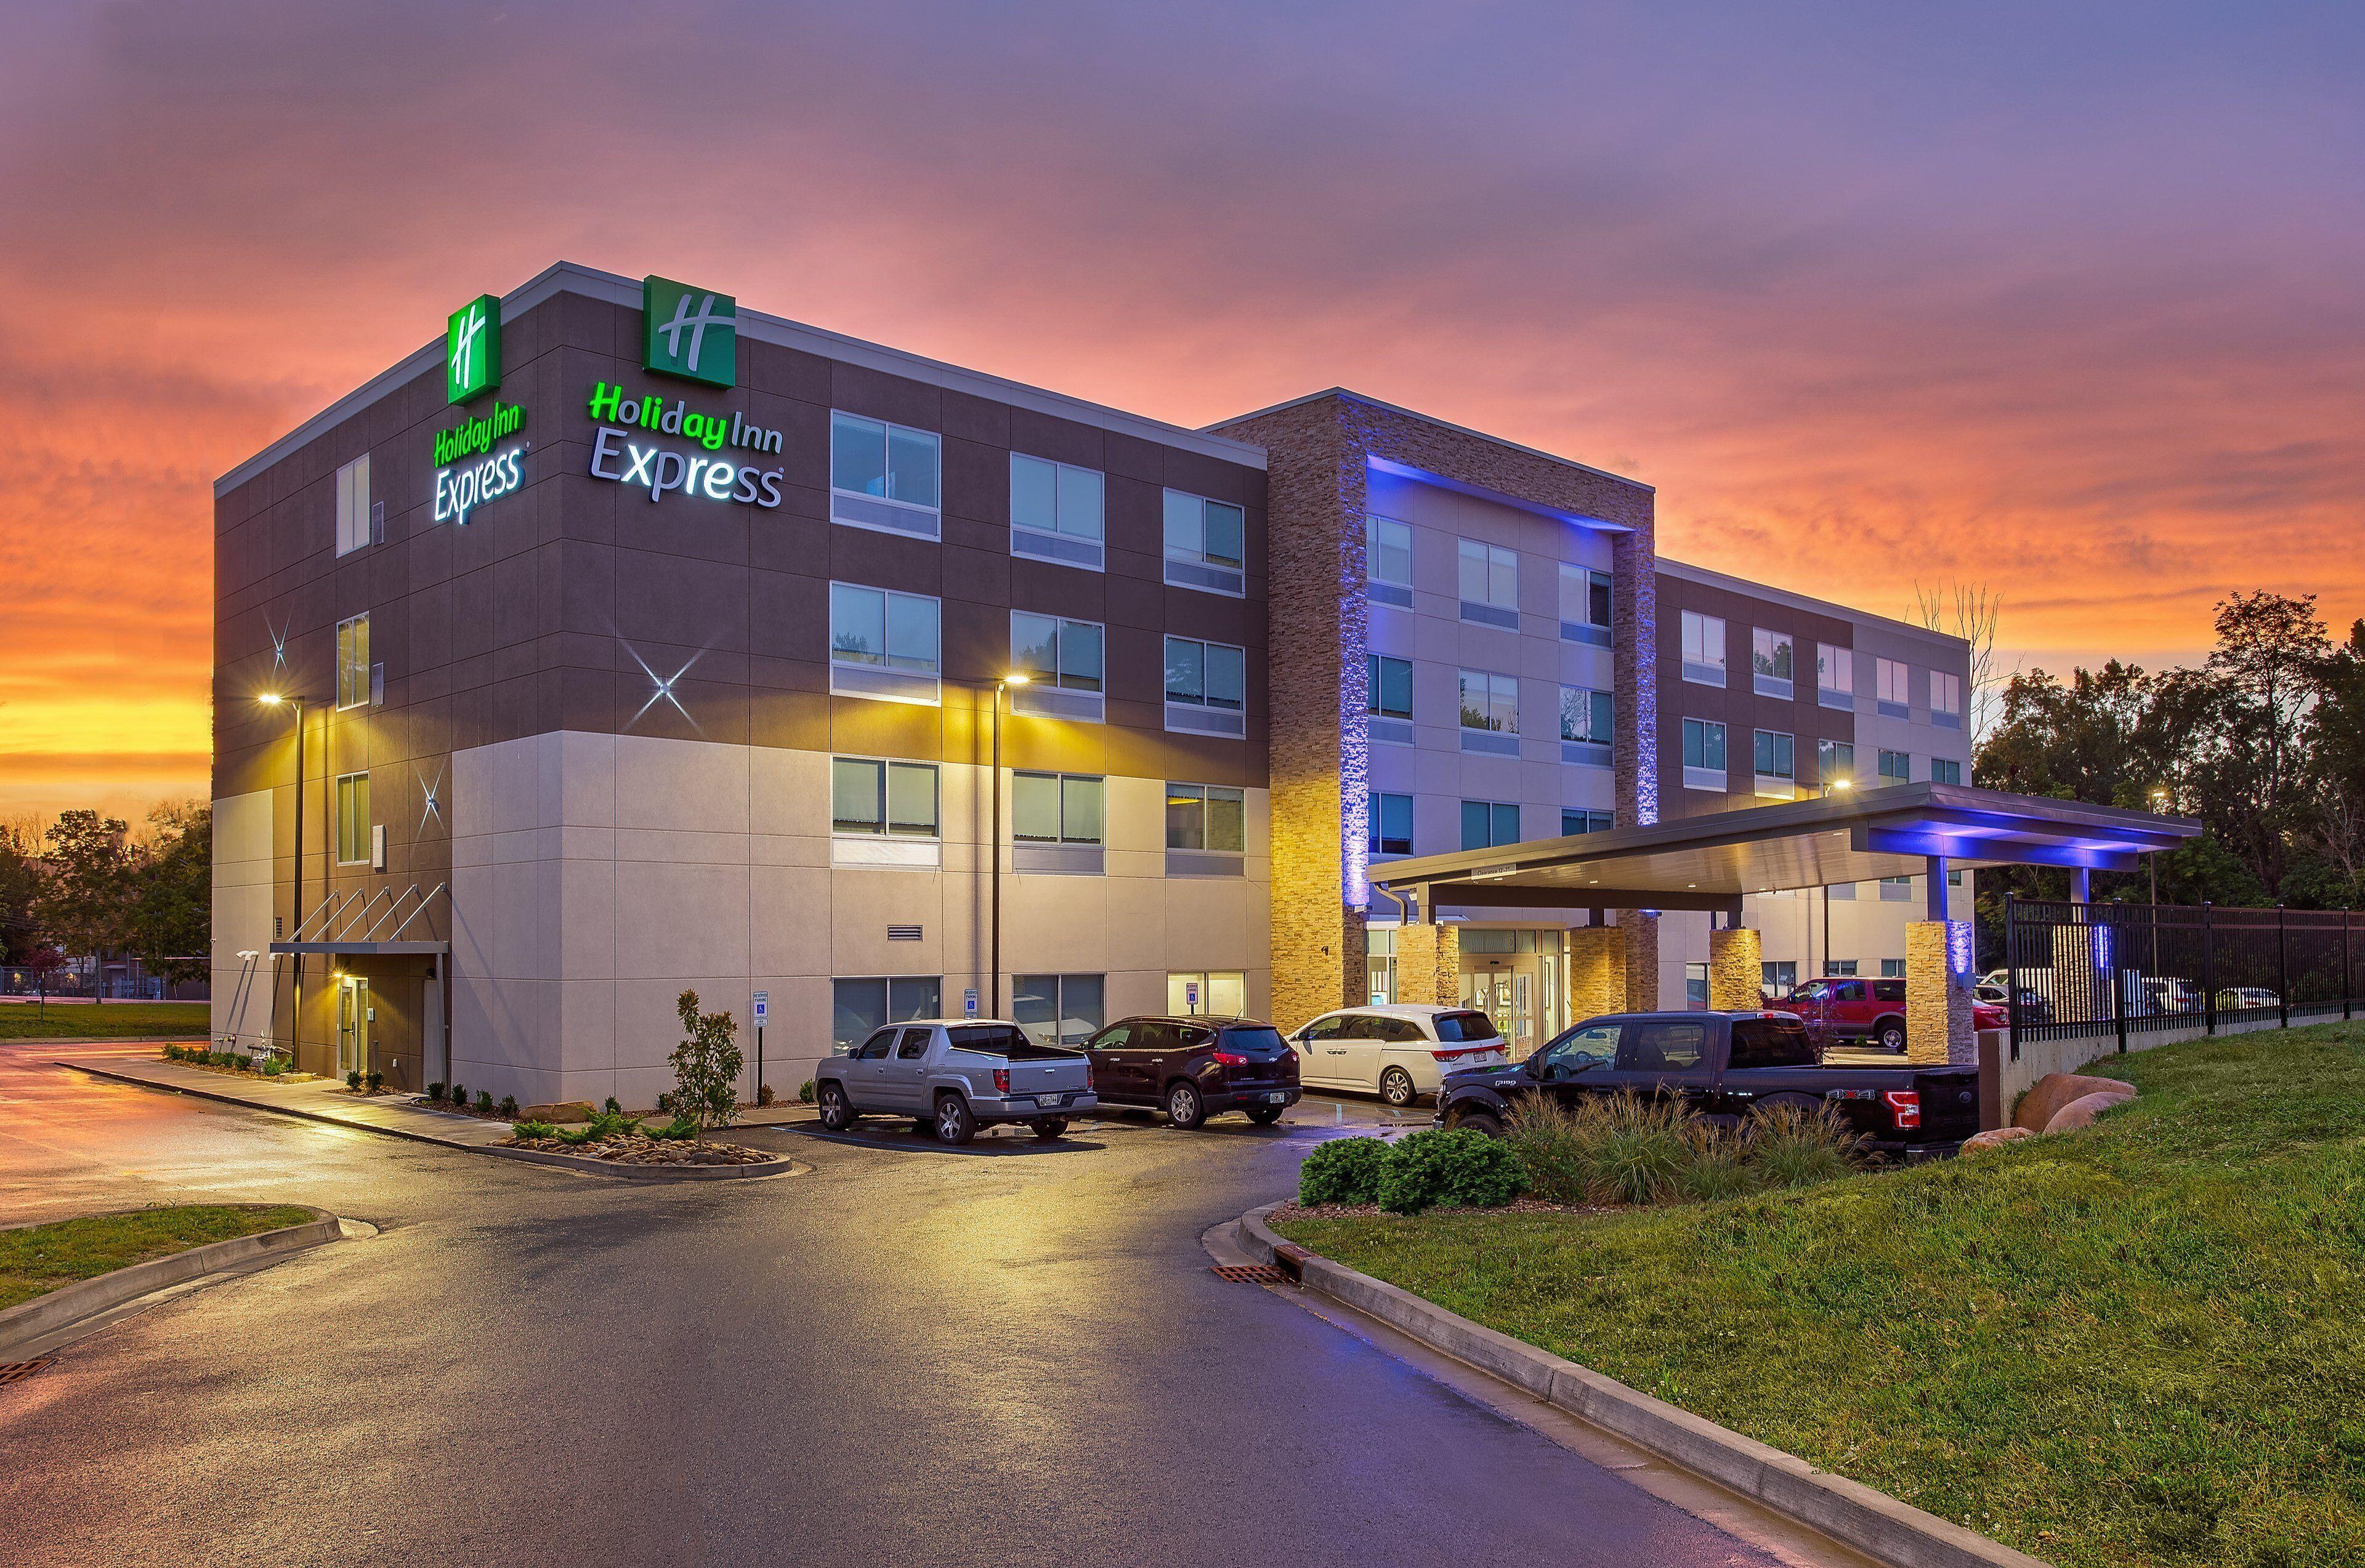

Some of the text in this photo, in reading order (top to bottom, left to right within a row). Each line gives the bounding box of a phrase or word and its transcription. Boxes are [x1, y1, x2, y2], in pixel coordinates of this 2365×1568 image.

[434, 401, 520, 468] Holiday Inn
[589, 381, 783, 455] Holiday Inn
[434, 448, 521, 525] Express
[589, 426, 783, 508] Express
